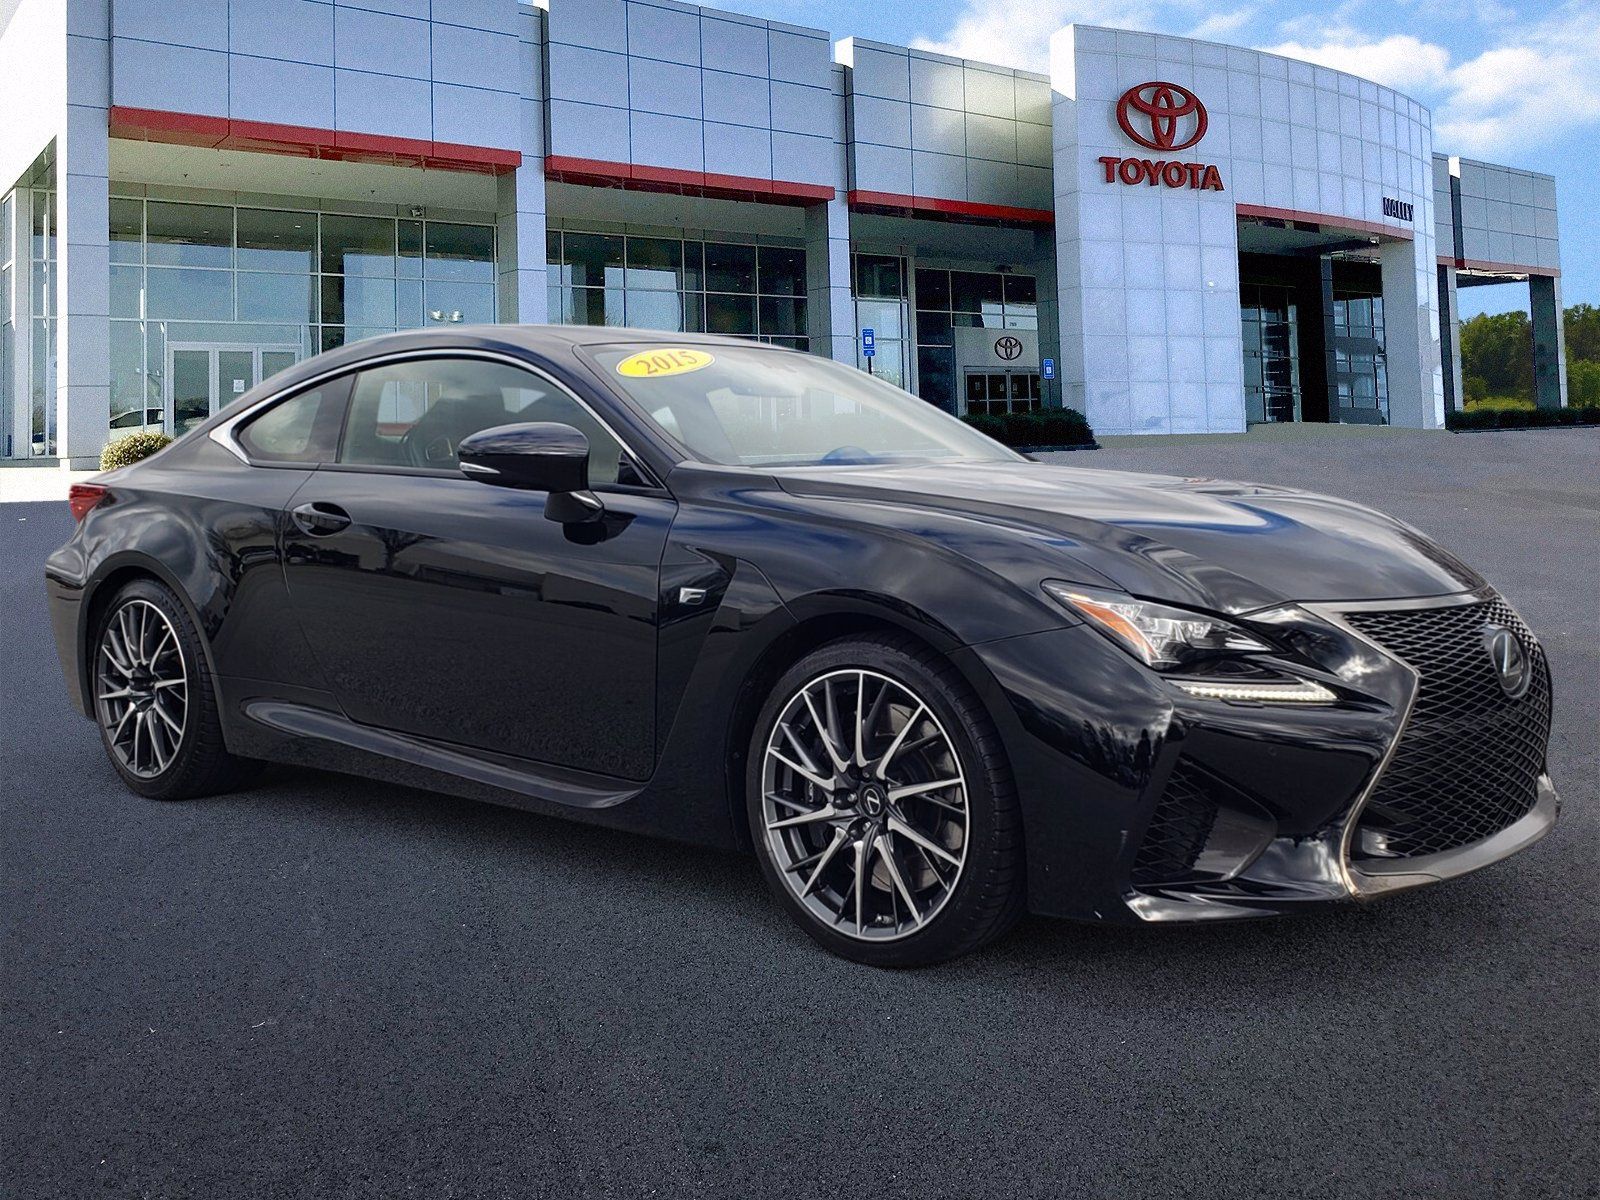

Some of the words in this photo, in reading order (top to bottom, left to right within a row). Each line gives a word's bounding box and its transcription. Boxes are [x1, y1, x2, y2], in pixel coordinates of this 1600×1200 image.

[1098, 156, 1225, 191] TOYOTA
[1383, 197, 1413, 222] NALLY
[636, 350, 698, 375] 2015
